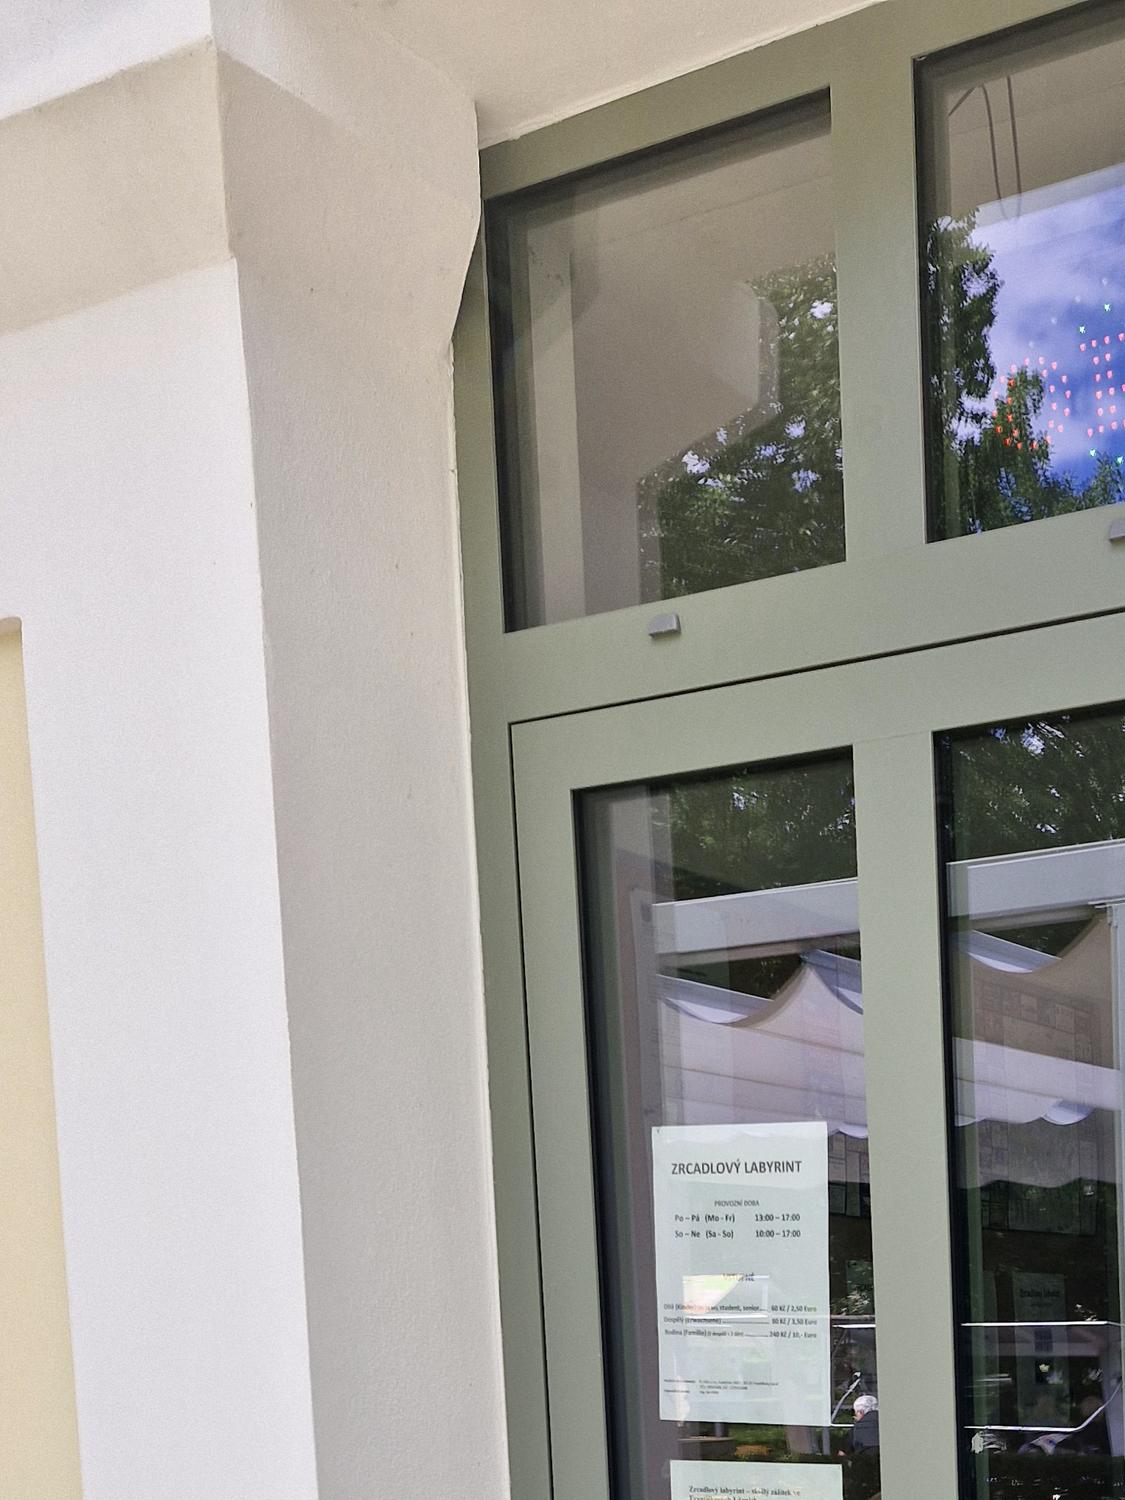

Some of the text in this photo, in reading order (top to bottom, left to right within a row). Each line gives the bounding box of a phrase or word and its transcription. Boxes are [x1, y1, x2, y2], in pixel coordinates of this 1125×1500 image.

[671, 1159, 803, 1175] ZRCADLOVÝ LABYRINT
[674, 1214, 684, 1222] Po
[704, 1214, 720, 1223] (Mo
[725, 1214, 736, 1223] Fr)
[755, 1213, 774, 1222] 13:00
[781, 1213, 801, 1222] 17:00
[674, 1230, 684, 1238] So
[690, 1230, 700, 1238] Ne
[705, 1229, 717, 1239] (Sa
[722, 1229, 734, 1239] So)
[755, 1230, 775, 1238] 10:00
[782, 1230, 801, 1238] 17:00
